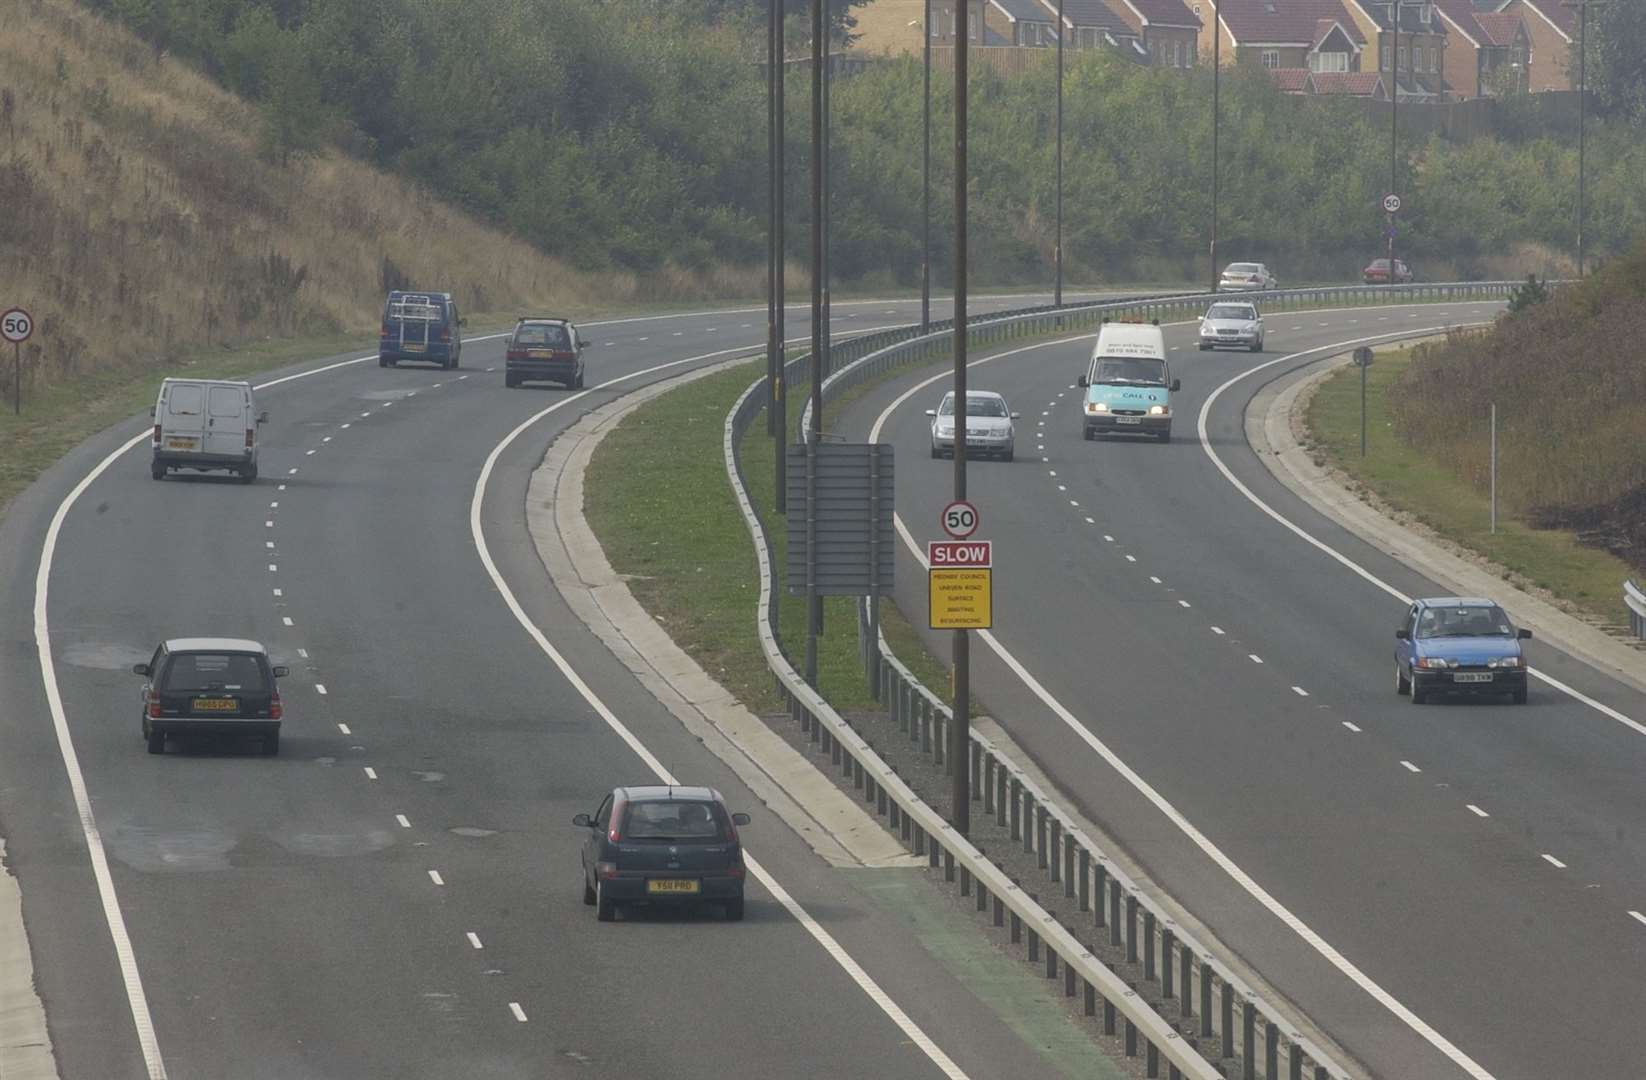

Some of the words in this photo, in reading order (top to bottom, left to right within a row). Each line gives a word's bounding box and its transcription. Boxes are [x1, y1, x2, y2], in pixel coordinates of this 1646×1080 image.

[1386, 199, 1399, 208] 50
[5, 319, 28, 334] 50
[947, 510, 974, 528] 50
[934, 547, 986, 562] SLOW
